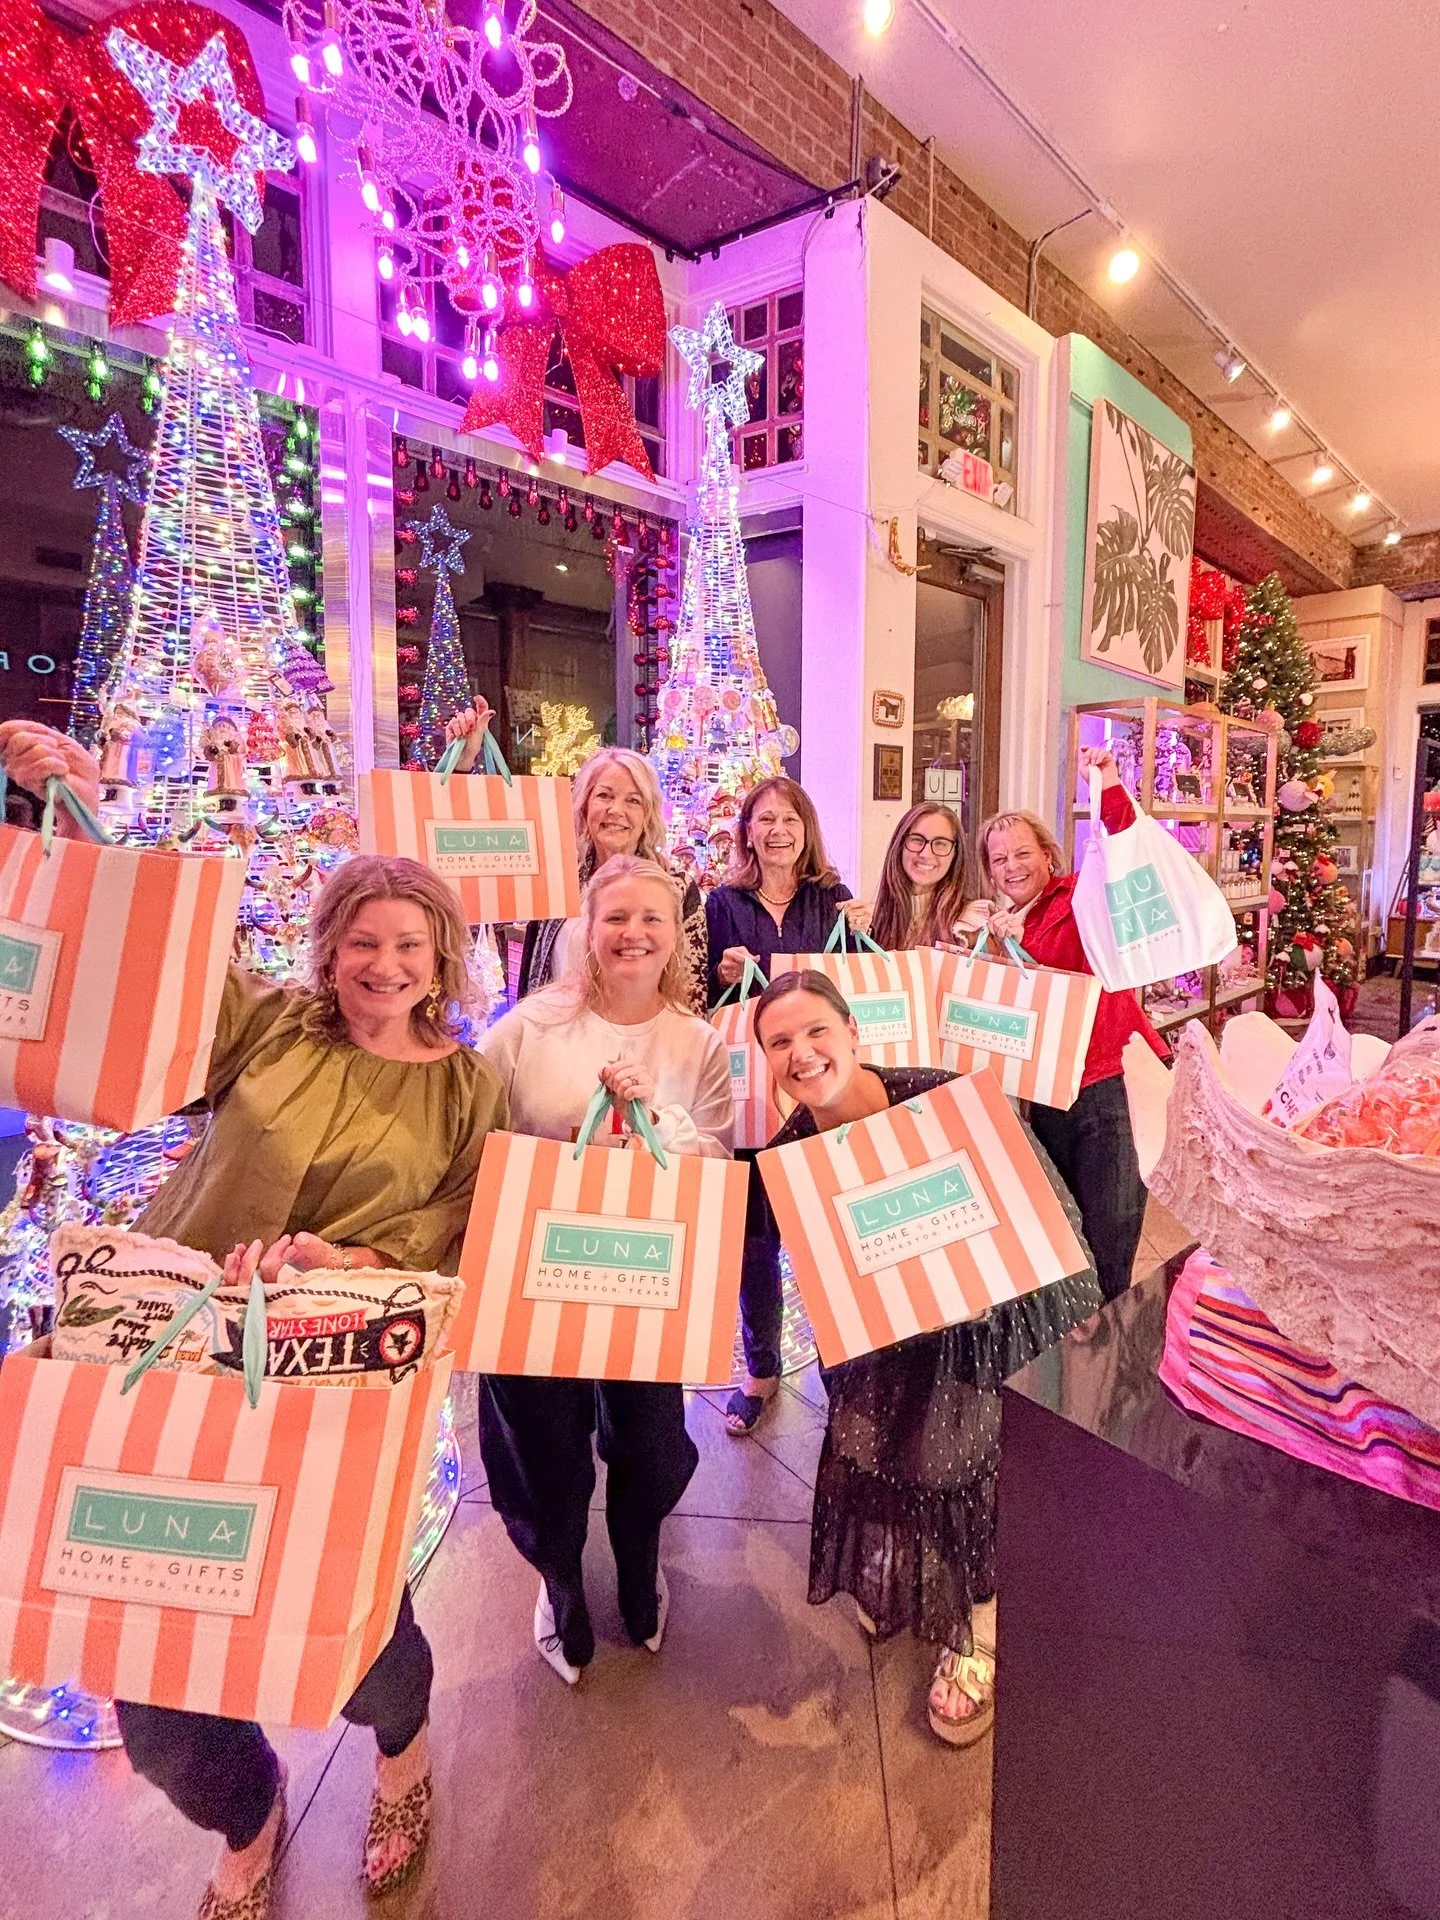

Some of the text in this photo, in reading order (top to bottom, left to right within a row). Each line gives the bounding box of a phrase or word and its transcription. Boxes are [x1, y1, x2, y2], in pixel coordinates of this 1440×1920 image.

[444, 835, 521, 847] LUNA
[437, 855, 475, 863] HOME
[861, 1005, 901, 1018] UNA
[954, 1009, 1021, 1031] LUNA
[945, 1023, 1026, 1047] HOME GIFTS
[861, 1179, 958, 1225] LUNA
[861, 1228, 909, 1252] HOME
[931, 1201, 980, 1226] GIFTS
[556, 1235, 663, 1260] LUNA
[539, 1268, 592, 1280] HOME
[618, 1274, 670, 1286] GIFTS
[629, 1288, 669, 1297] TEXAS
[268, 1313, 358, 1338] LONE STAR
[268, 1332, 365, 1376] TEXA
[85, 1505, 237, 1543] LUNA
[61, 1549, 133, 1569] HOME
[168, 1562, 244, 1581] GIFTS
[182, 1584, 241, 1597] TEXAS
